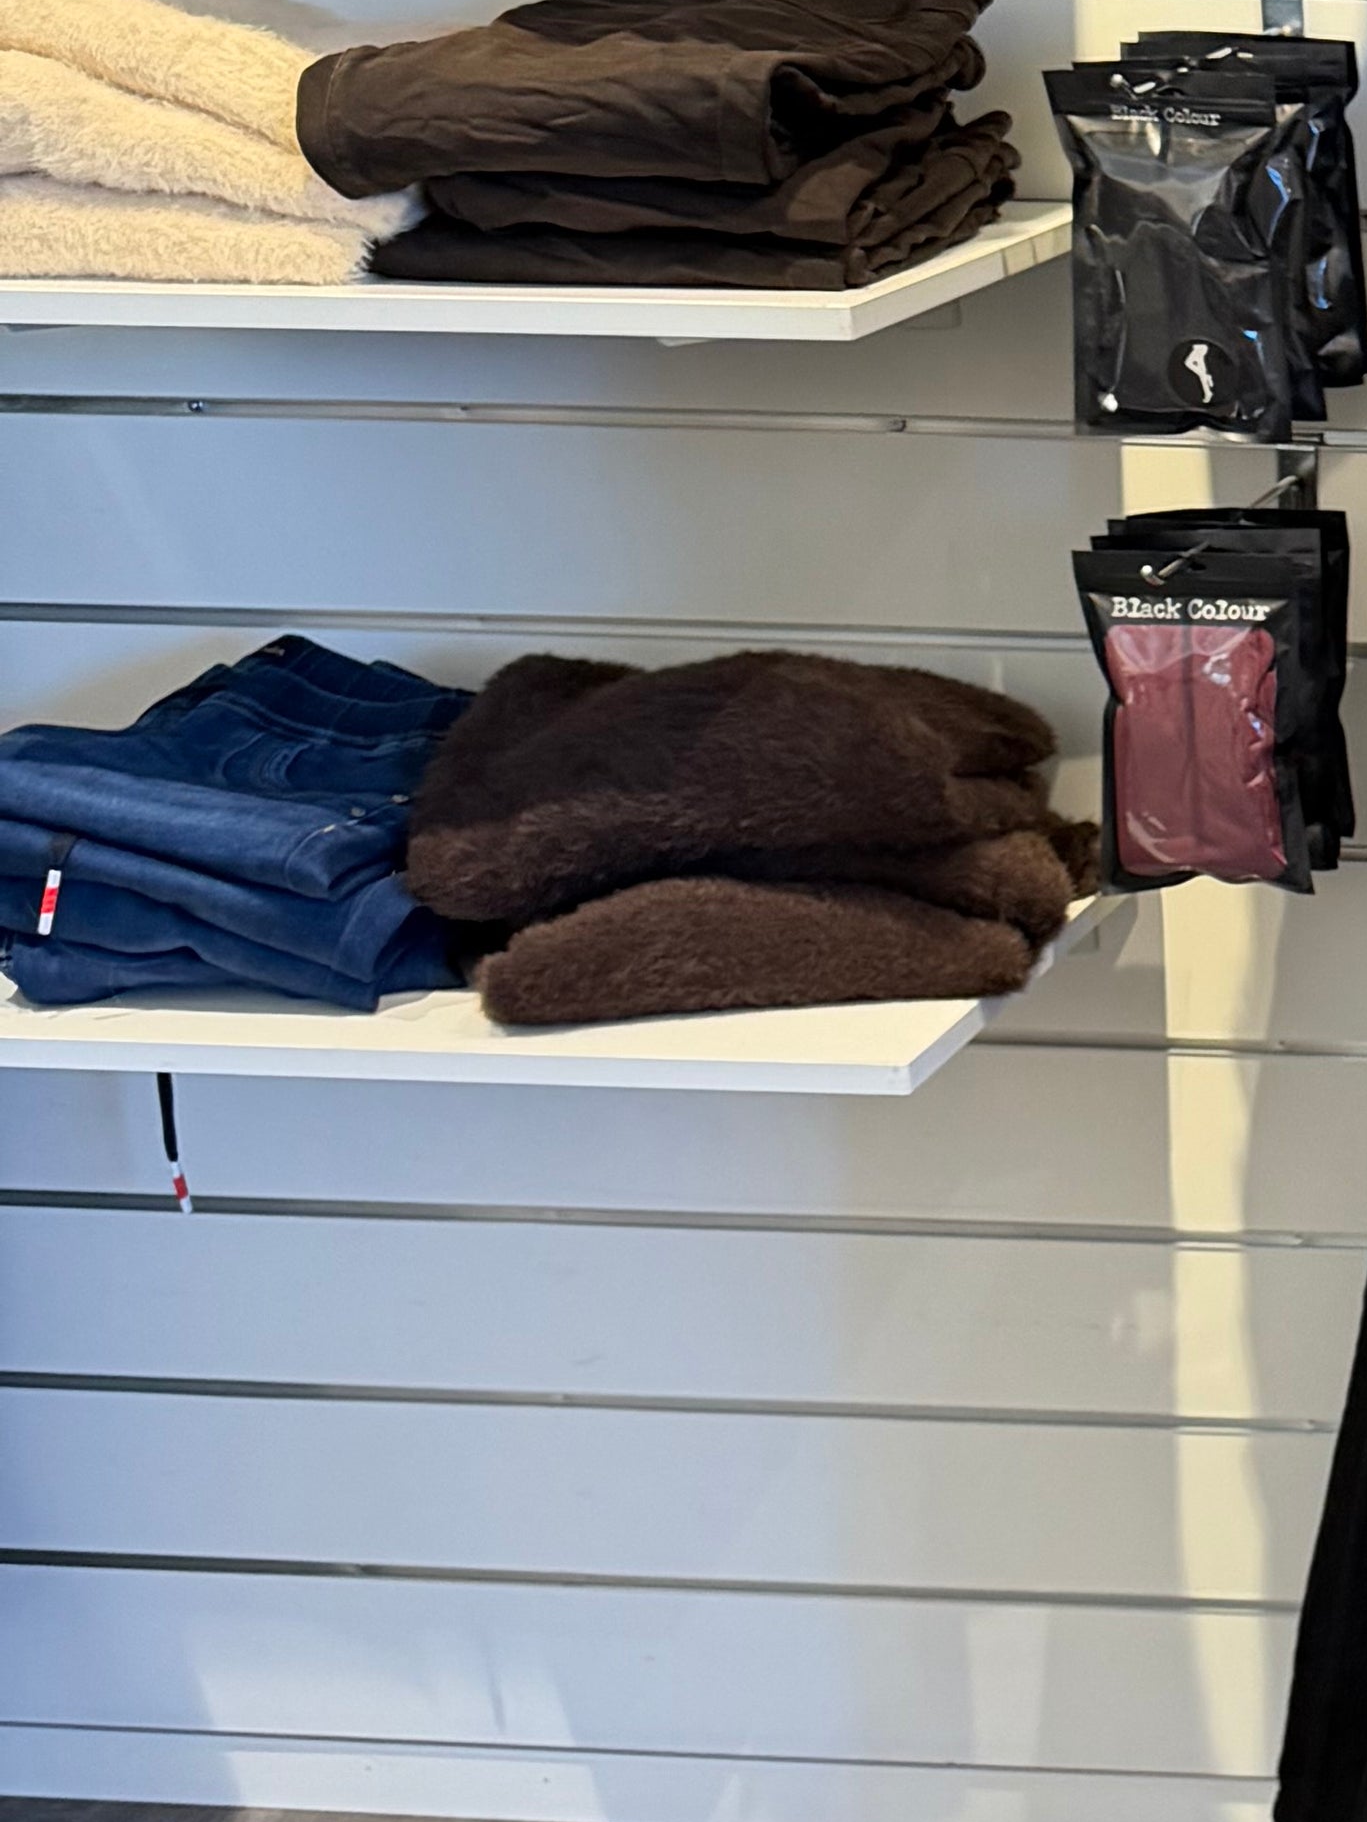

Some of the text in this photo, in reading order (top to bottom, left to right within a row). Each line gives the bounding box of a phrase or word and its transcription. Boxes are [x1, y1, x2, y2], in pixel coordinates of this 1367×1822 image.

[1163, 107, 1221, 126] Colour
[1111, 596, 1271, 621] Black Colour
